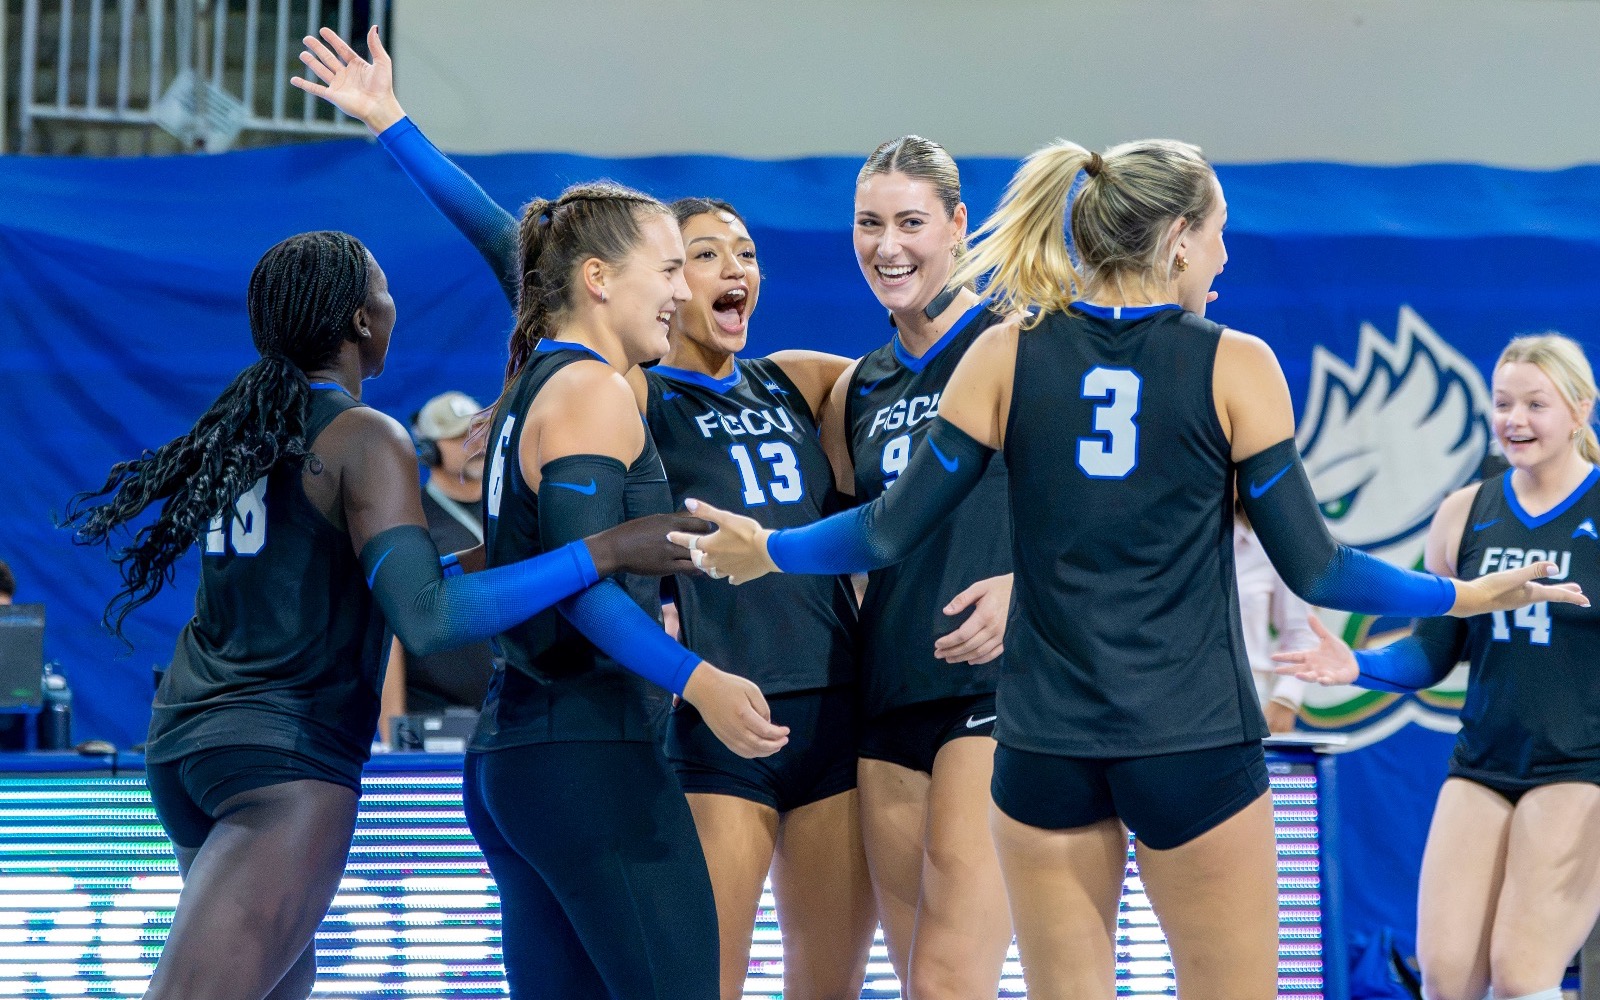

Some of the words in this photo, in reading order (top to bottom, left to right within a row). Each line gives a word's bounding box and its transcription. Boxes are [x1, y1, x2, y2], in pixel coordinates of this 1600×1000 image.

[695, 406, 794, 438] FGCU
[868, 393, 941, 437] FGCU
[1076, 365, 1143, 480] 3
[729, 441, 805, 508] 13
[880, 432, 912, 491] 9
[1492, 600, 1552, 646] 14
